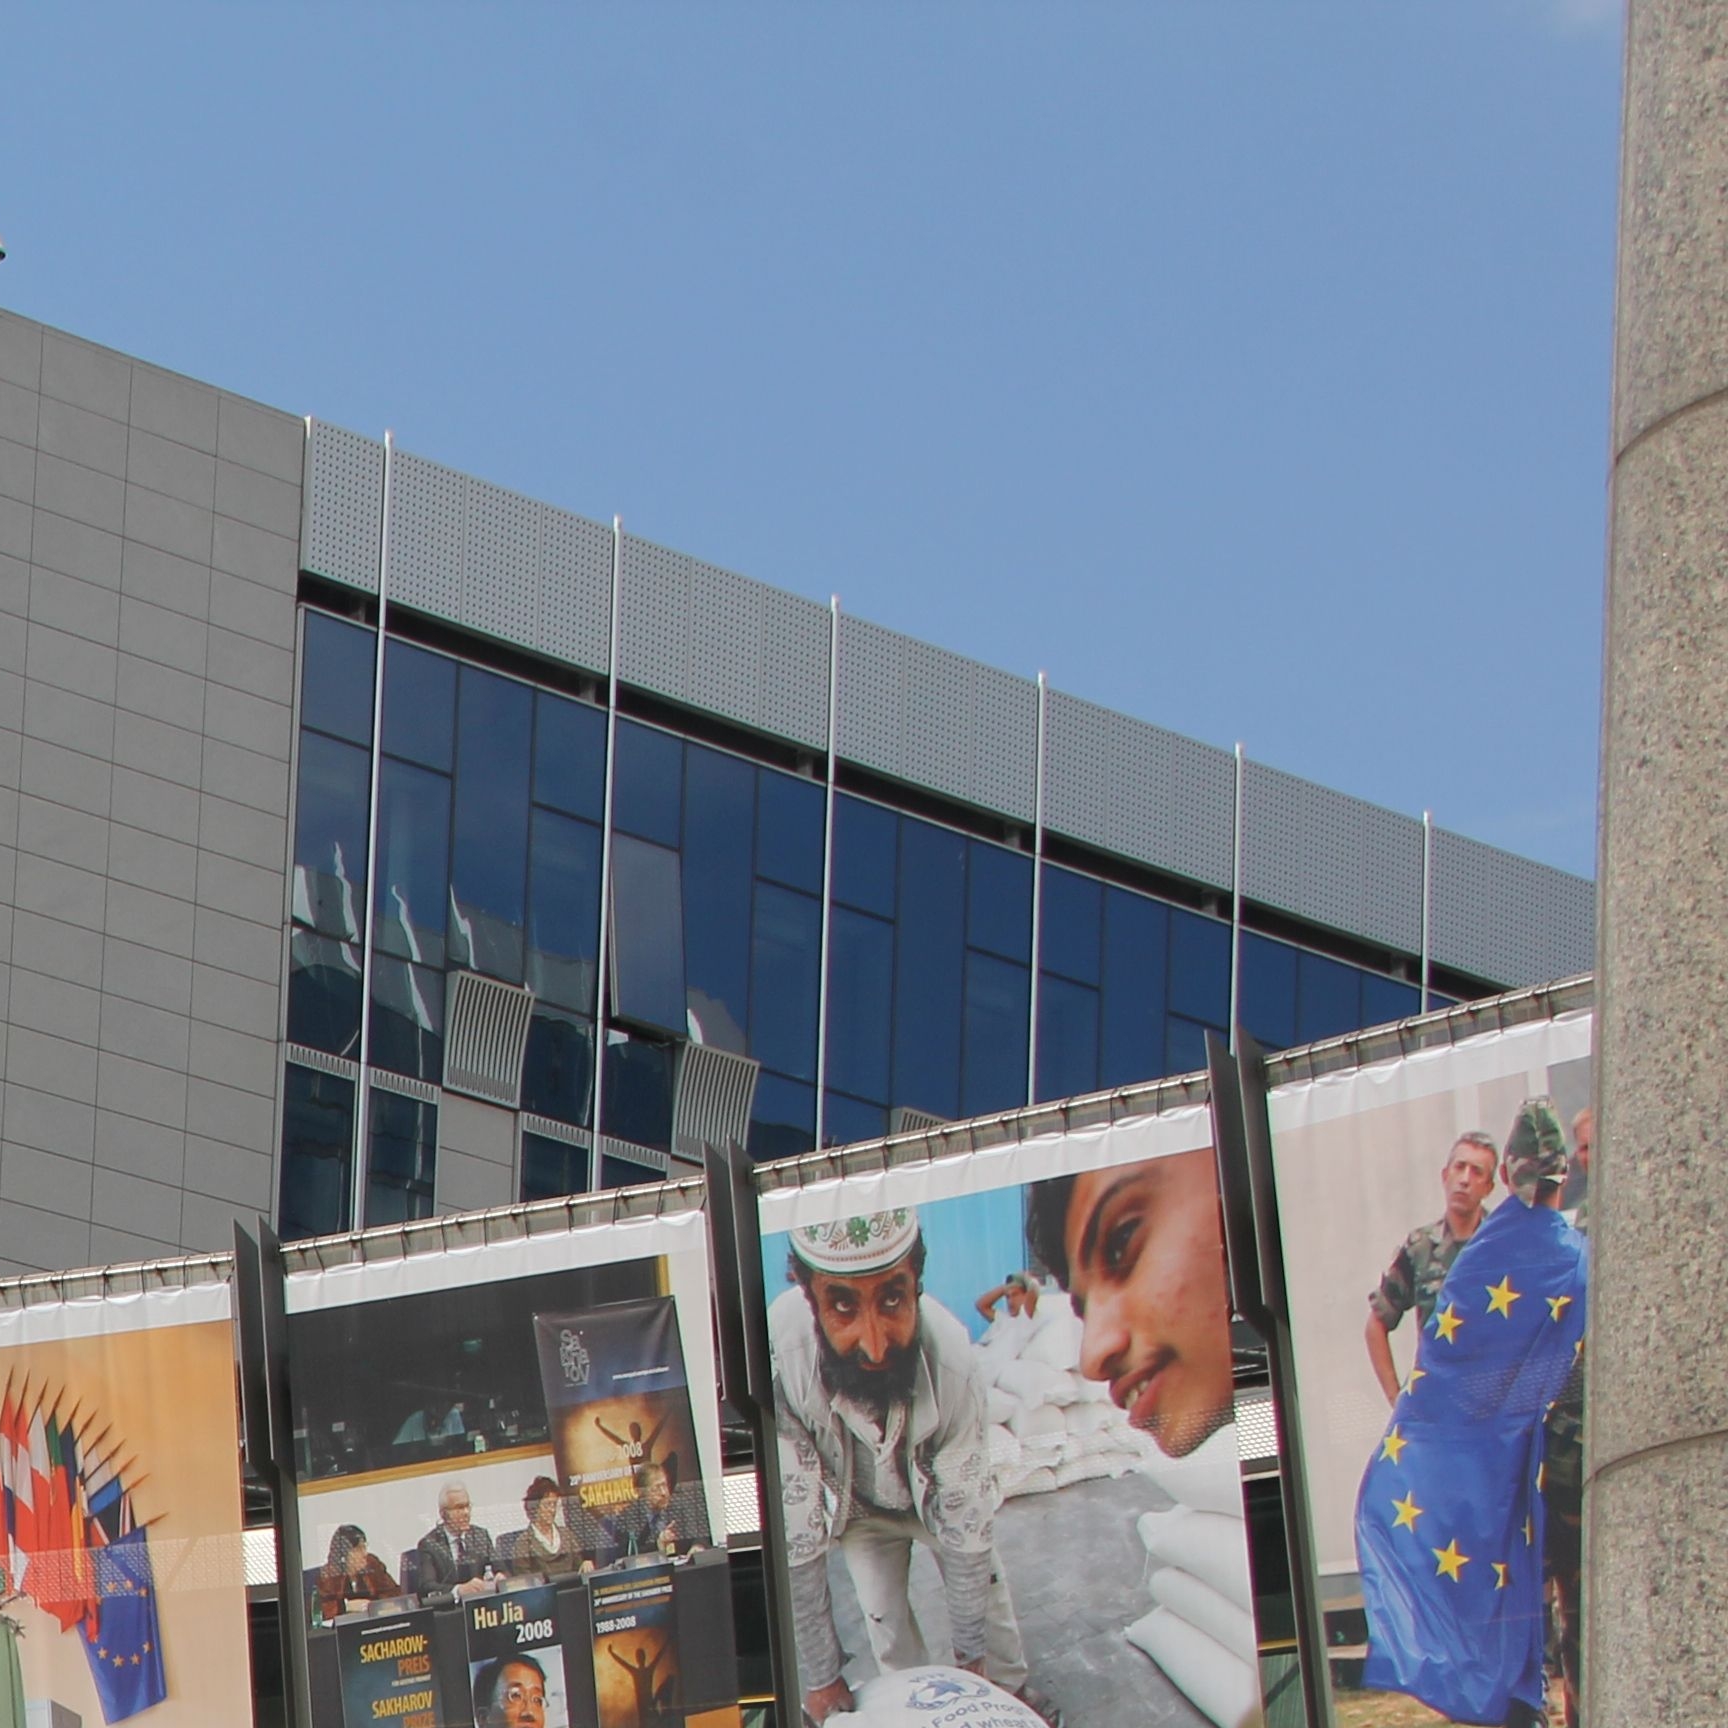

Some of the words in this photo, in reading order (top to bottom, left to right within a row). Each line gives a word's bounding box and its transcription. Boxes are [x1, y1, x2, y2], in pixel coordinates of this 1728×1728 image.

[474, 1607, 496, 1630] Hu
[500, 1601, 524, 1624] Jia
[516, 1619, 553, 1644] 2008
[360, 1634, 428, 1664] SACHAROW-
[397, 1654, 431, 1677] PREIS
[371, 1690, 433, 1720] SAKHAROV
[931, 1702, 979, 1728] Food
